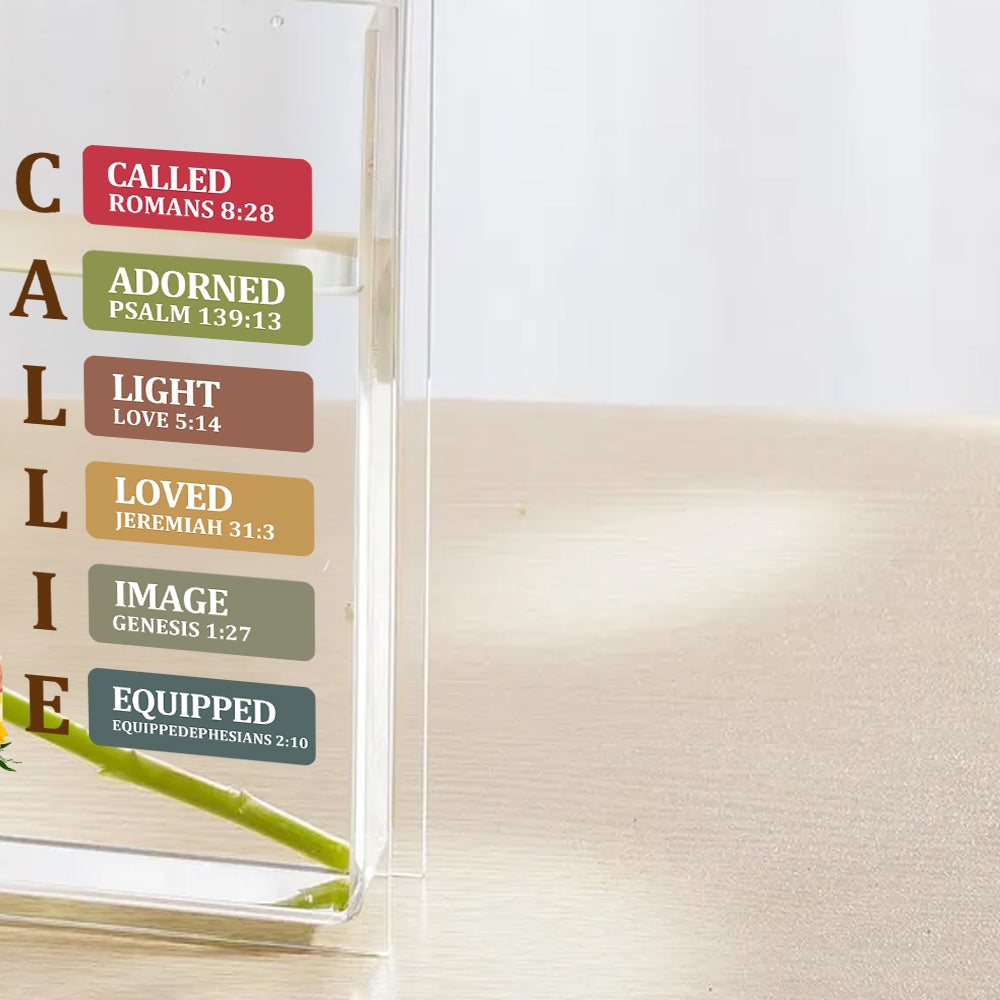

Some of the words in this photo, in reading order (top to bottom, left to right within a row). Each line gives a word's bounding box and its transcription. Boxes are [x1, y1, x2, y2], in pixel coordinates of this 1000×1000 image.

[107, 162, 231, 194] CALLED
[109, 193, 214, 219] ROMANS
[221, 201, 274, 223] 8:28
[108, 267, 285, 305] ADORNED
[109, 300, 190, 324] PSALM
[199, 307, 281, 331] 139:13
[112, 373, 221, 408] LIGHT
[113, 408, 169, 428] LOVE
[175, 413, 222, 433] 5:14
[115, 476, 233, 512] LOVED
[116, 511, 222, 536] JEREMIAH
[229, 521, 275, 540] 31:3
[114, 580, 229, 617] IMAGE
[112, 614, 200, 638] GENESIS
[206, 623, 251, 642] 1:27
[112, 686, 276, 725] EQUIPPED
[112, 719, 272, 746] EQUIPPEDEPHESIANS
[276, 735, 308, 749] 2:10
